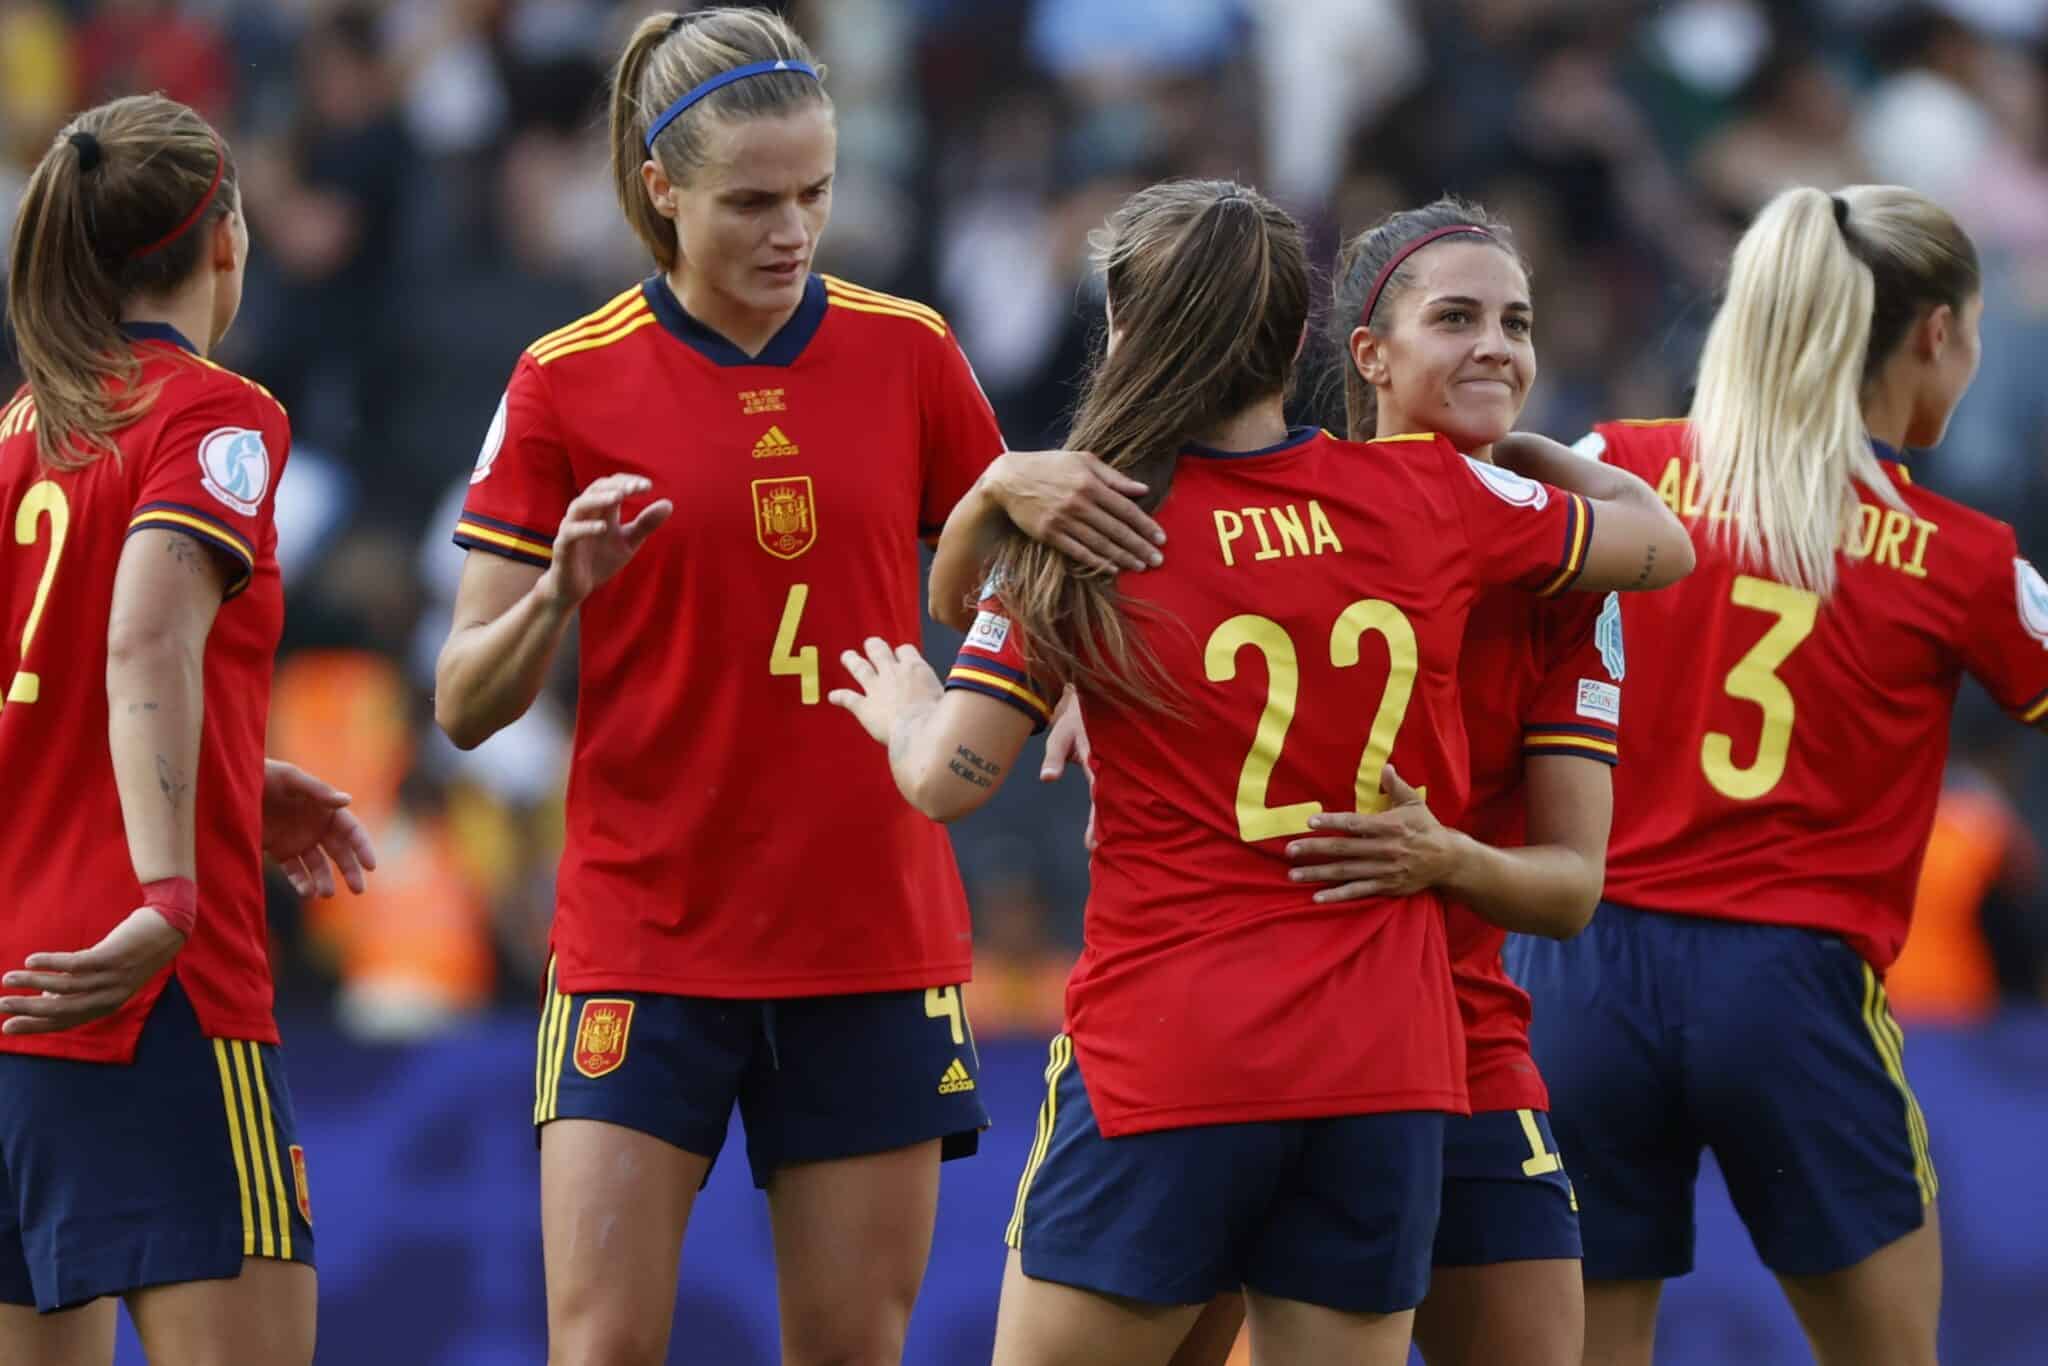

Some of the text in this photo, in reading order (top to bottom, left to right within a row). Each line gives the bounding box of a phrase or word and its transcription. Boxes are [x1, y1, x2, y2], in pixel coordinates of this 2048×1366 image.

[1213, 499, 1343, 566] PINA
[770, 583, 820, 705] 4
[1701, 575, 1820, 800] 3
[1204, 599, 1427, 842] 22
[924, 985, 964, 1045] 4
[1517, 1109, 1563, 1176] 1
